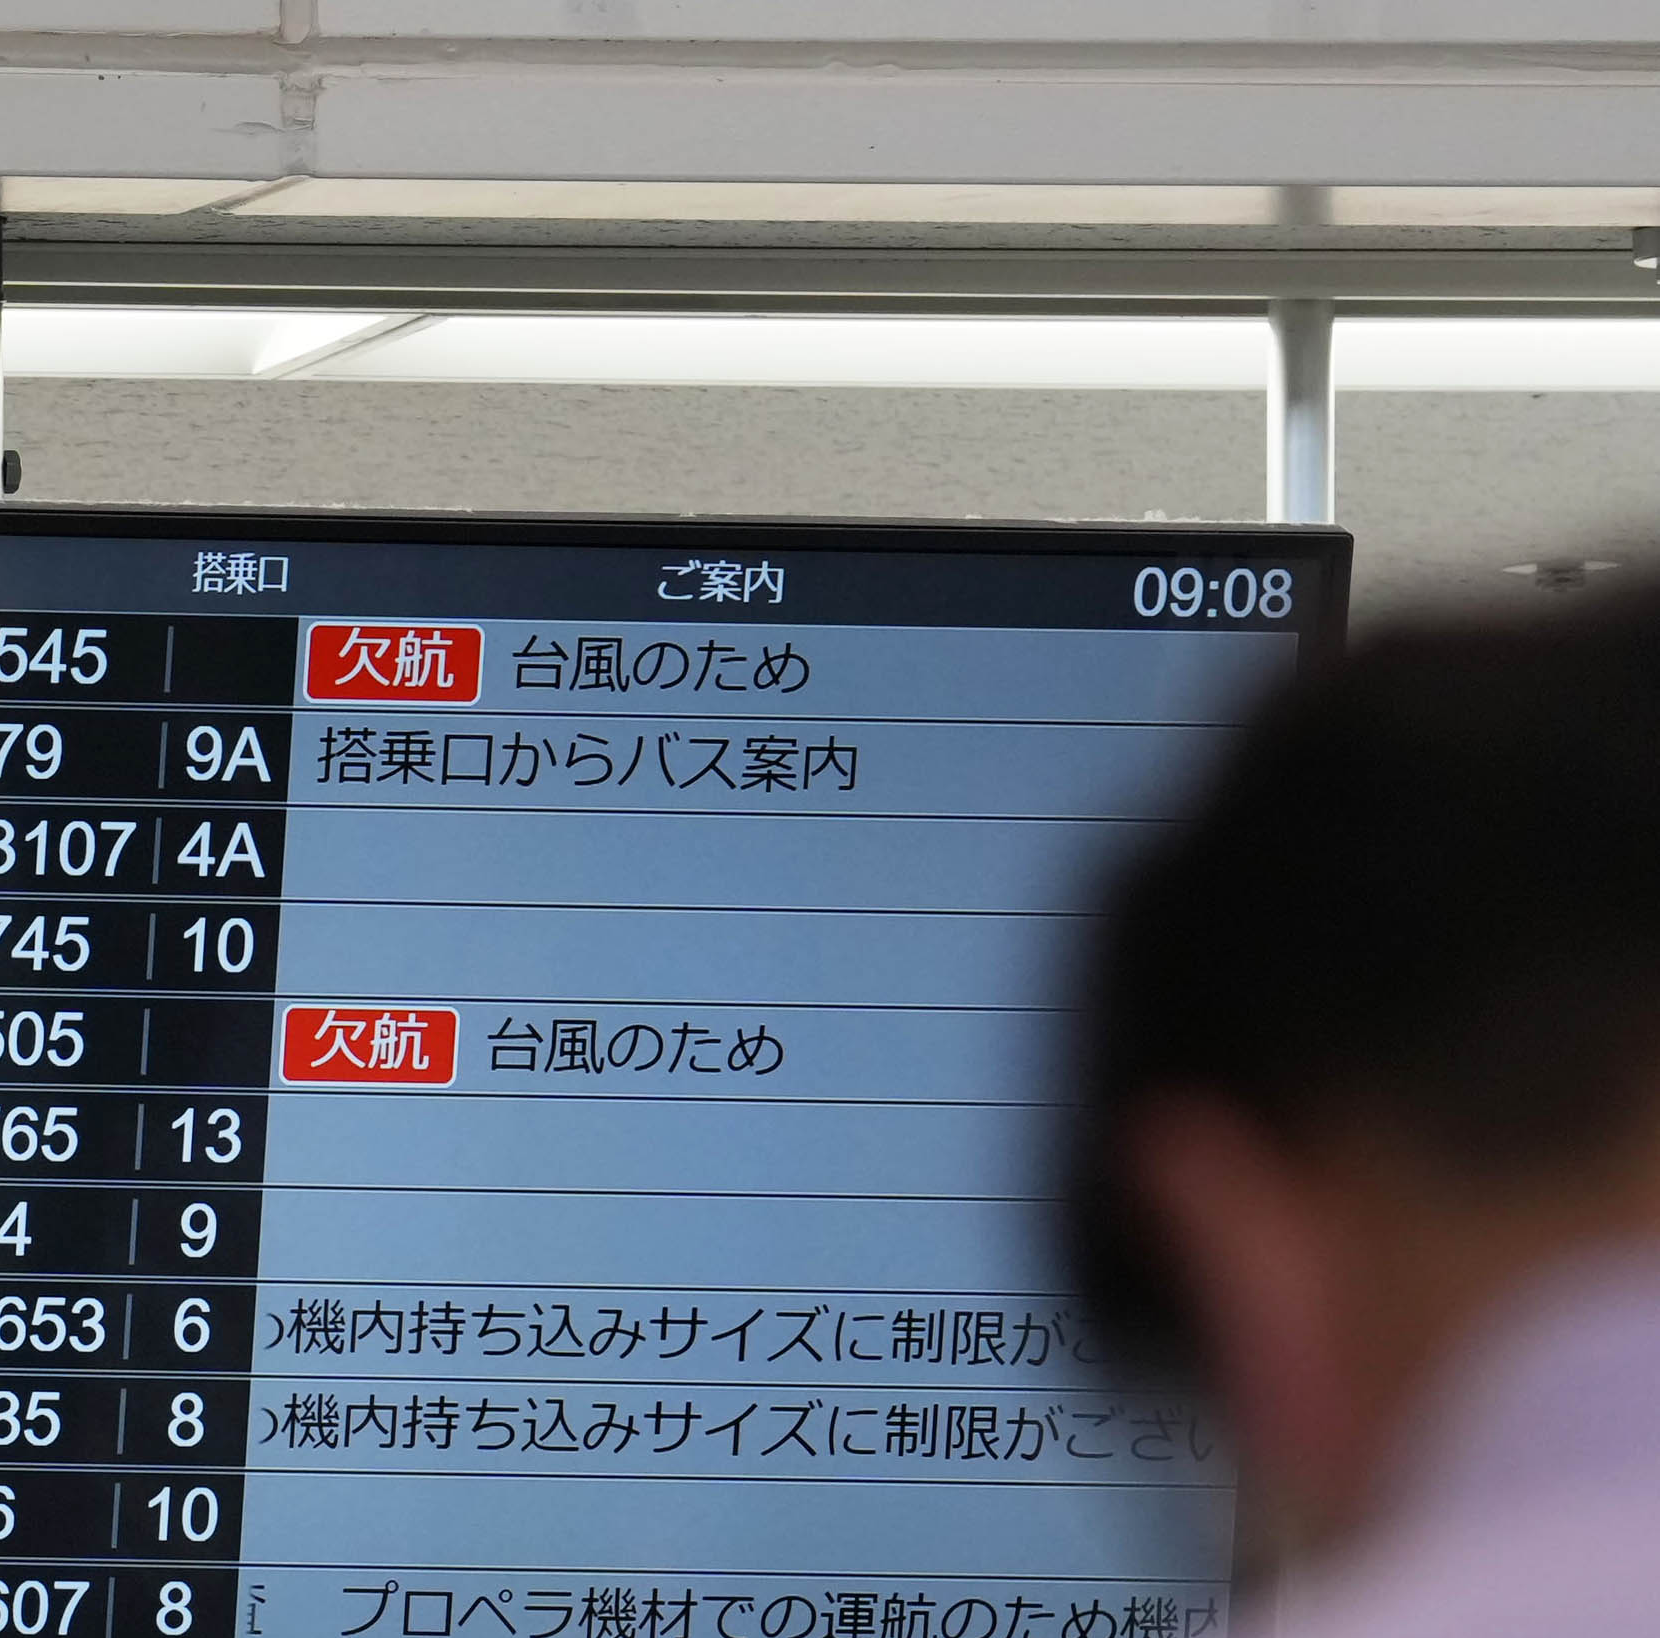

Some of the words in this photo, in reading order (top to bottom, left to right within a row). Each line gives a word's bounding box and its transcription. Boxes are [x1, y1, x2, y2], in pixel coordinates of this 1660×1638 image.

[191, 551, 289, 595] 搭乗口
[657, 559, 785, 604] ご案内
[1133, 566, 1292, 619] 09:08
[334, 626, 455, 688] 欠航
[511, 634, 810, 694] 台風のため
[185, 725, 272, 783] 9A
[316, 726, 858, 793] 搭乗口からバス案内
[177, 821, 266, 878] 4A
[183, 916, 254, 973] 10
[310, 1009, 430, 1070] 欠航
[487, 1016, 784, 1076] 台風のため
[171, 1107, 242, 1164] 13
[180, 1202, 217, 1258] 9
[173, 1297, 211, 1353] 6
[267, 1297, 1095, 1368] 機内持ち込みサイズに制限が
[167, 1392, 205, 1447] 8
[260, 1392, 1214, 1463] 機内持ち込みサイズに制限がござ
[147, 1486, 219, 1542] 10
[155, 1581, 193, 1636] 8
